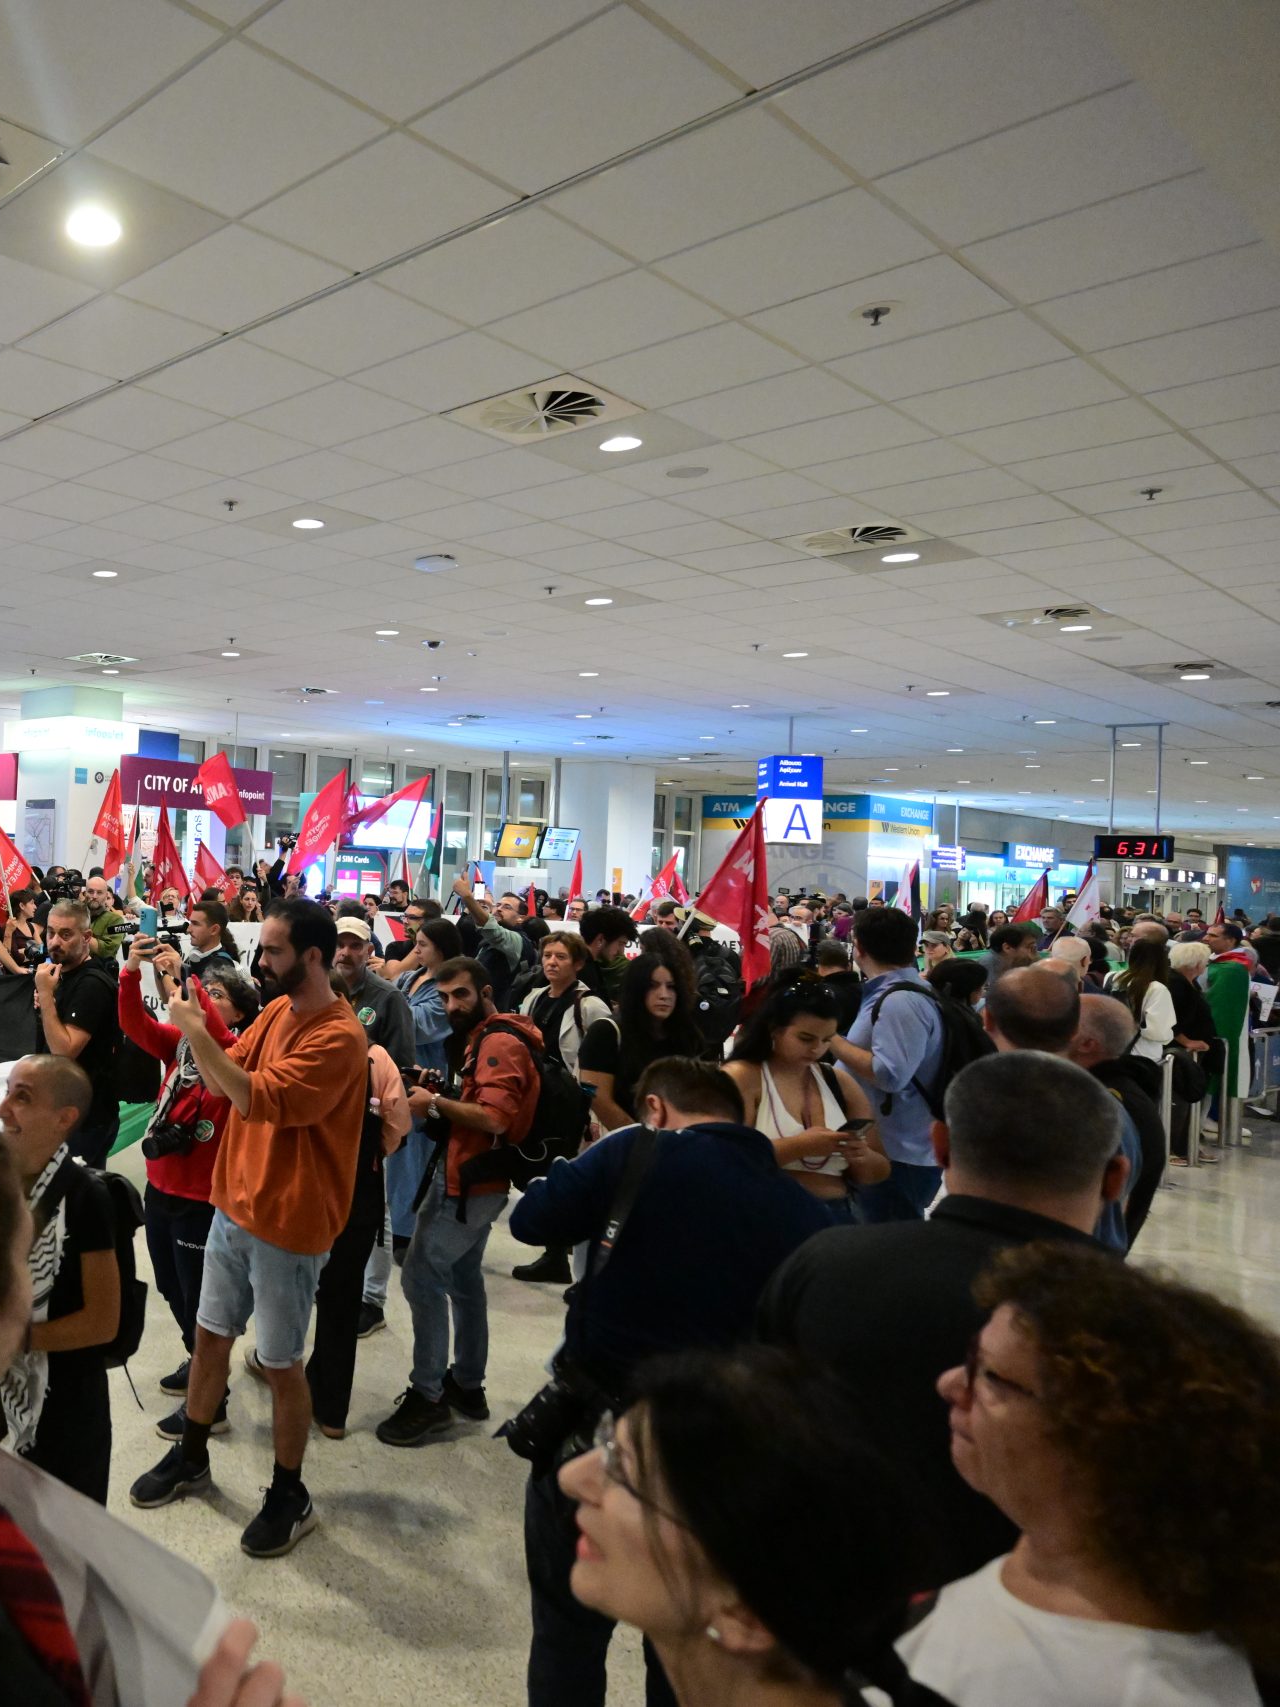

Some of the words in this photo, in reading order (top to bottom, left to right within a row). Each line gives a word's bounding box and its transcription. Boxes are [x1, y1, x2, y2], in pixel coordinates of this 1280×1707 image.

[144, 774, 171, 792] CITY
[172, 777, 189, 793] OF
[237, 788, 265, 801] nfopoint
[712, 802, 740, 812] ATM
[873, 803, 886, 815] ATM
[900, 806, 930, 821] EXCHANGE
[782, 803, 812, 840] A
[908, 826, 920, 835] Union
[342, 855, 354, 863] SIM
[354, 856, 370, 864] Cards
[1015, 844, 1055, 863] EXCHANGE
